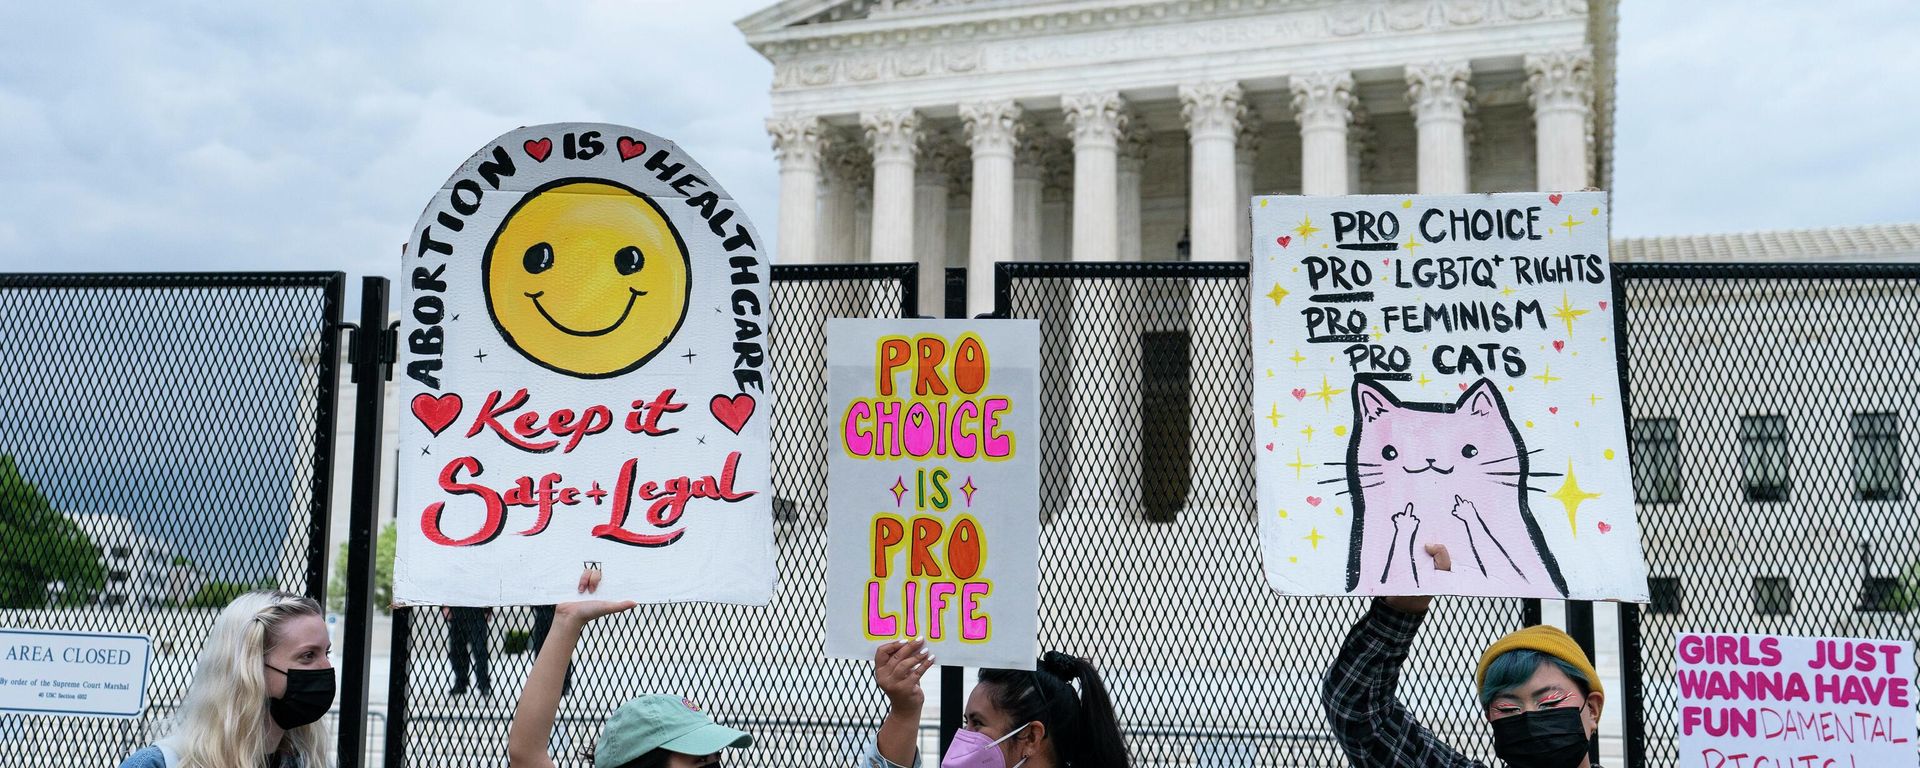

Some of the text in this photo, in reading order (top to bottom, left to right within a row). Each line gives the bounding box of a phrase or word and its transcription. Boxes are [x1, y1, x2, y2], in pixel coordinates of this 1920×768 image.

[1331, 206, 1543, 243] PRO CHOICE
[407, 131, 764, 394] ABORTION IS HEALTHCARE
[1301, 255, 1373, 291] PRO
[1510, 253, 1605, 285] RIGHTS
[1301, 299, 1548, 341] PRO FEMINISM
[879, 335, 987, 397] PRO
[1343, 343, 1527, 378] PRO CATS
[465, 387, 688, 454] Keep it
[844, 398, 1011, 458] CHOICE
[917, 469, 950, 509] IS
[873, 516, 981, 580] PRO
[866, 581, 990, 640] LIFE
[6, 645, 131, 665] AREA CLOSED
[1679, 635, 1902, 675] GIRLS JUST
[30, 679, 38, 687] of
[40, 679, 51, 688] the
[52, 680, 80, 689] Supreme
[82, 681, 101, 689] Court
[103, 682, 130, 691] Marshal
[1678, 669, 1909, 708] WANNA HAVE
[1682, 706, 1909, 744] FUNDAMENTAL
